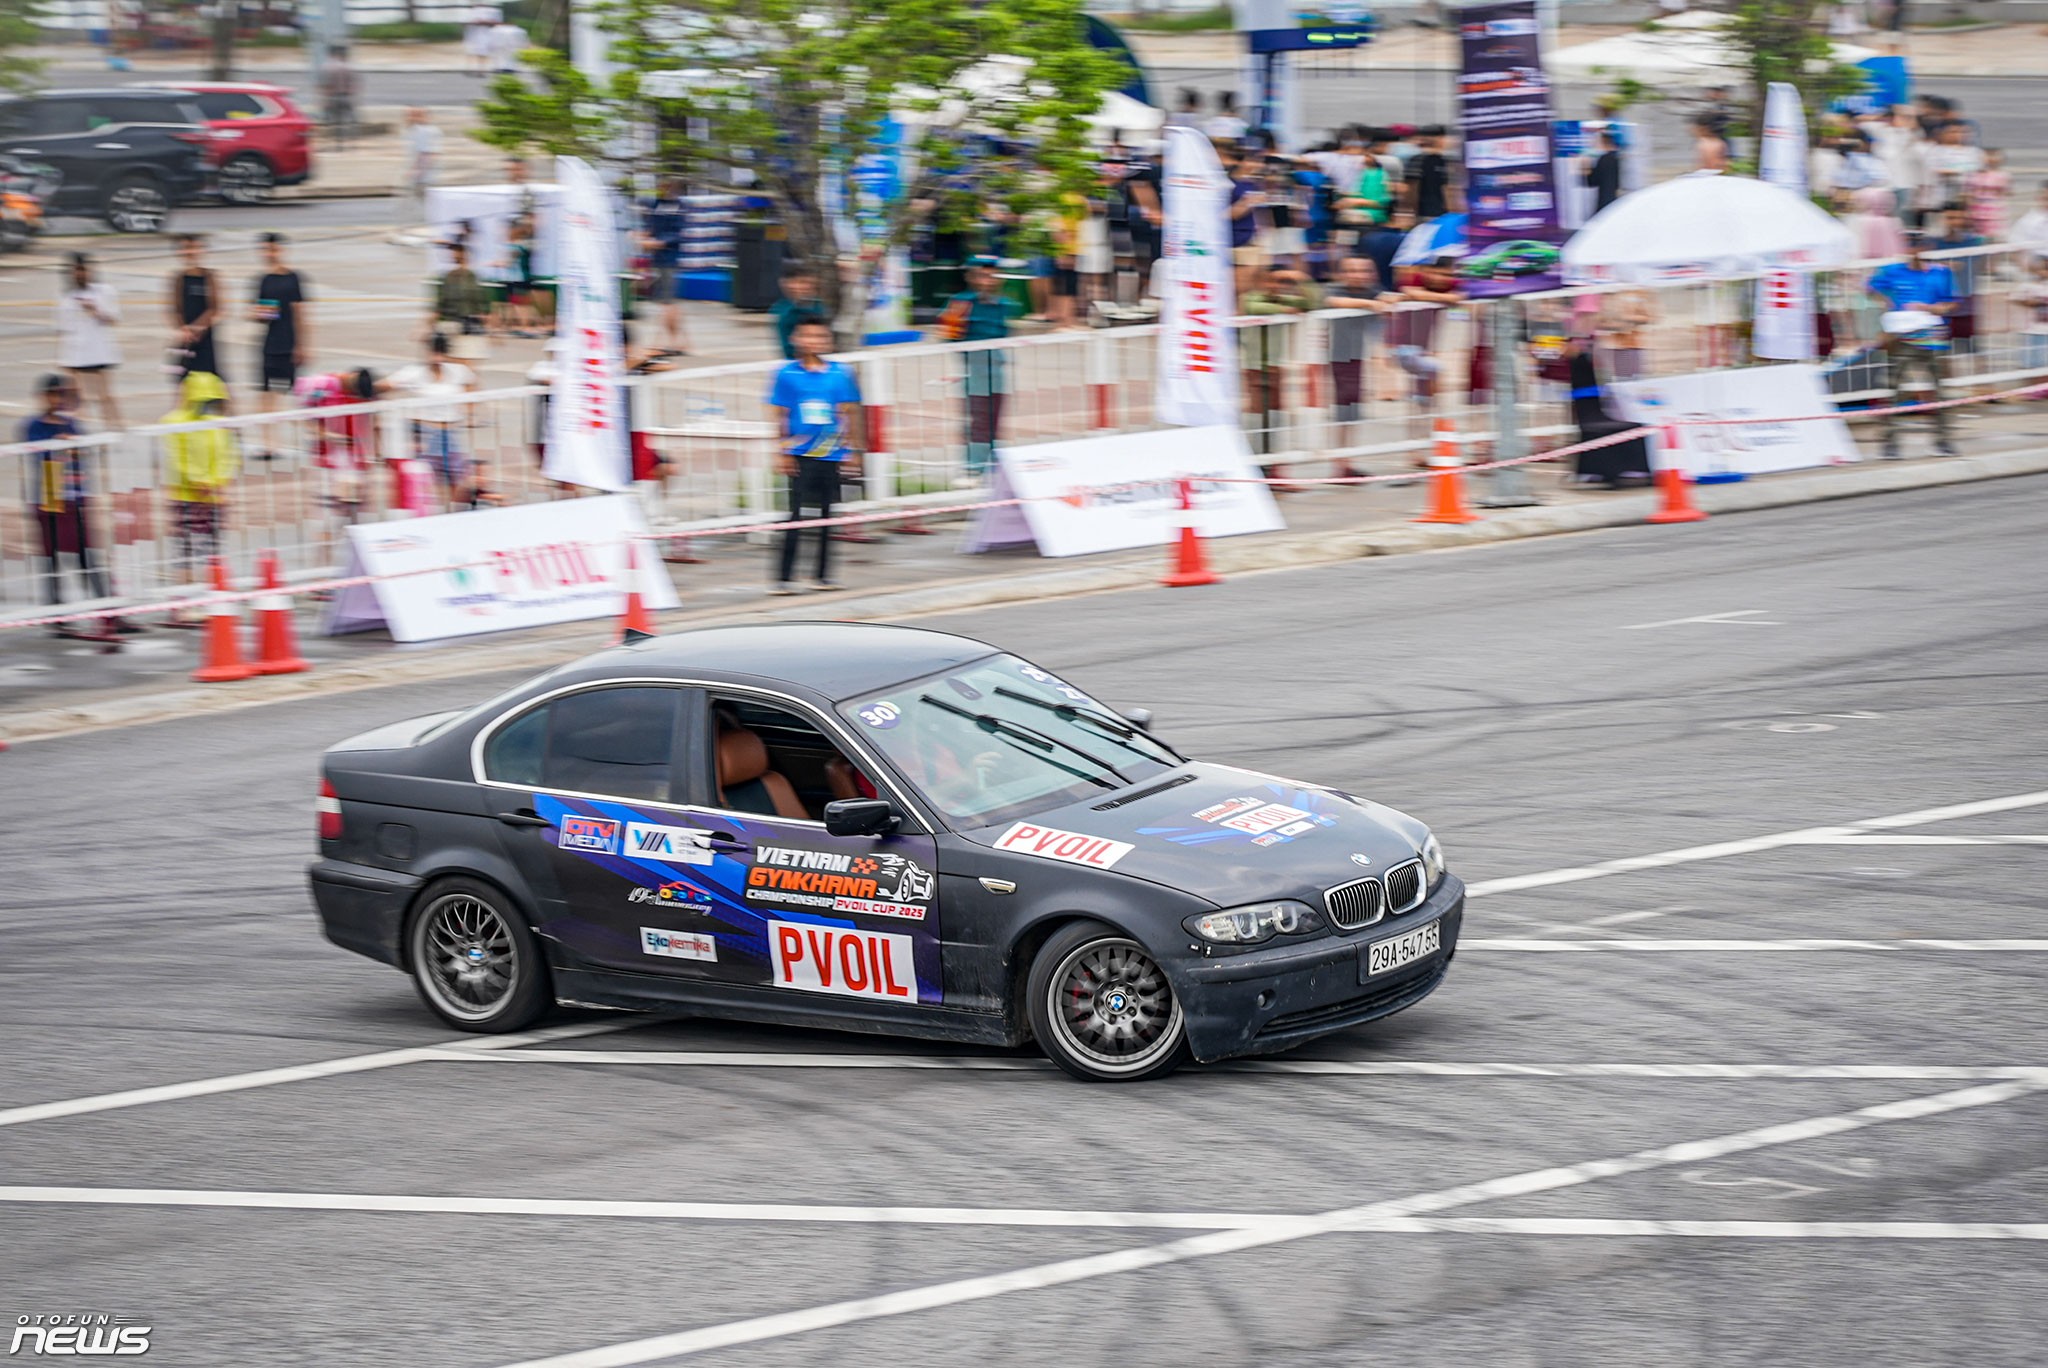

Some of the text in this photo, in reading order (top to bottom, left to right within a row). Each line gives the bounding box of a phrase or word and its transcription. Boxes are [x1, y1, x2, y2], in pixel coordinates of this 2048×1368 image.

[859, 706, 896, 726] 30
[1228, 807, 1304, 832] PVOIL
[1003, 825, 1114, 865] PVOIL
[756, 845, 852, 873] VIETNAM
[748, 867, 878, 899] GYMKHANA
[746, 888, 835, 908] CHAMPIONSHIP
[835, 899, 924, 919] PVOIL CUP 2025
[778, 926, 909, 997] PVOIL
